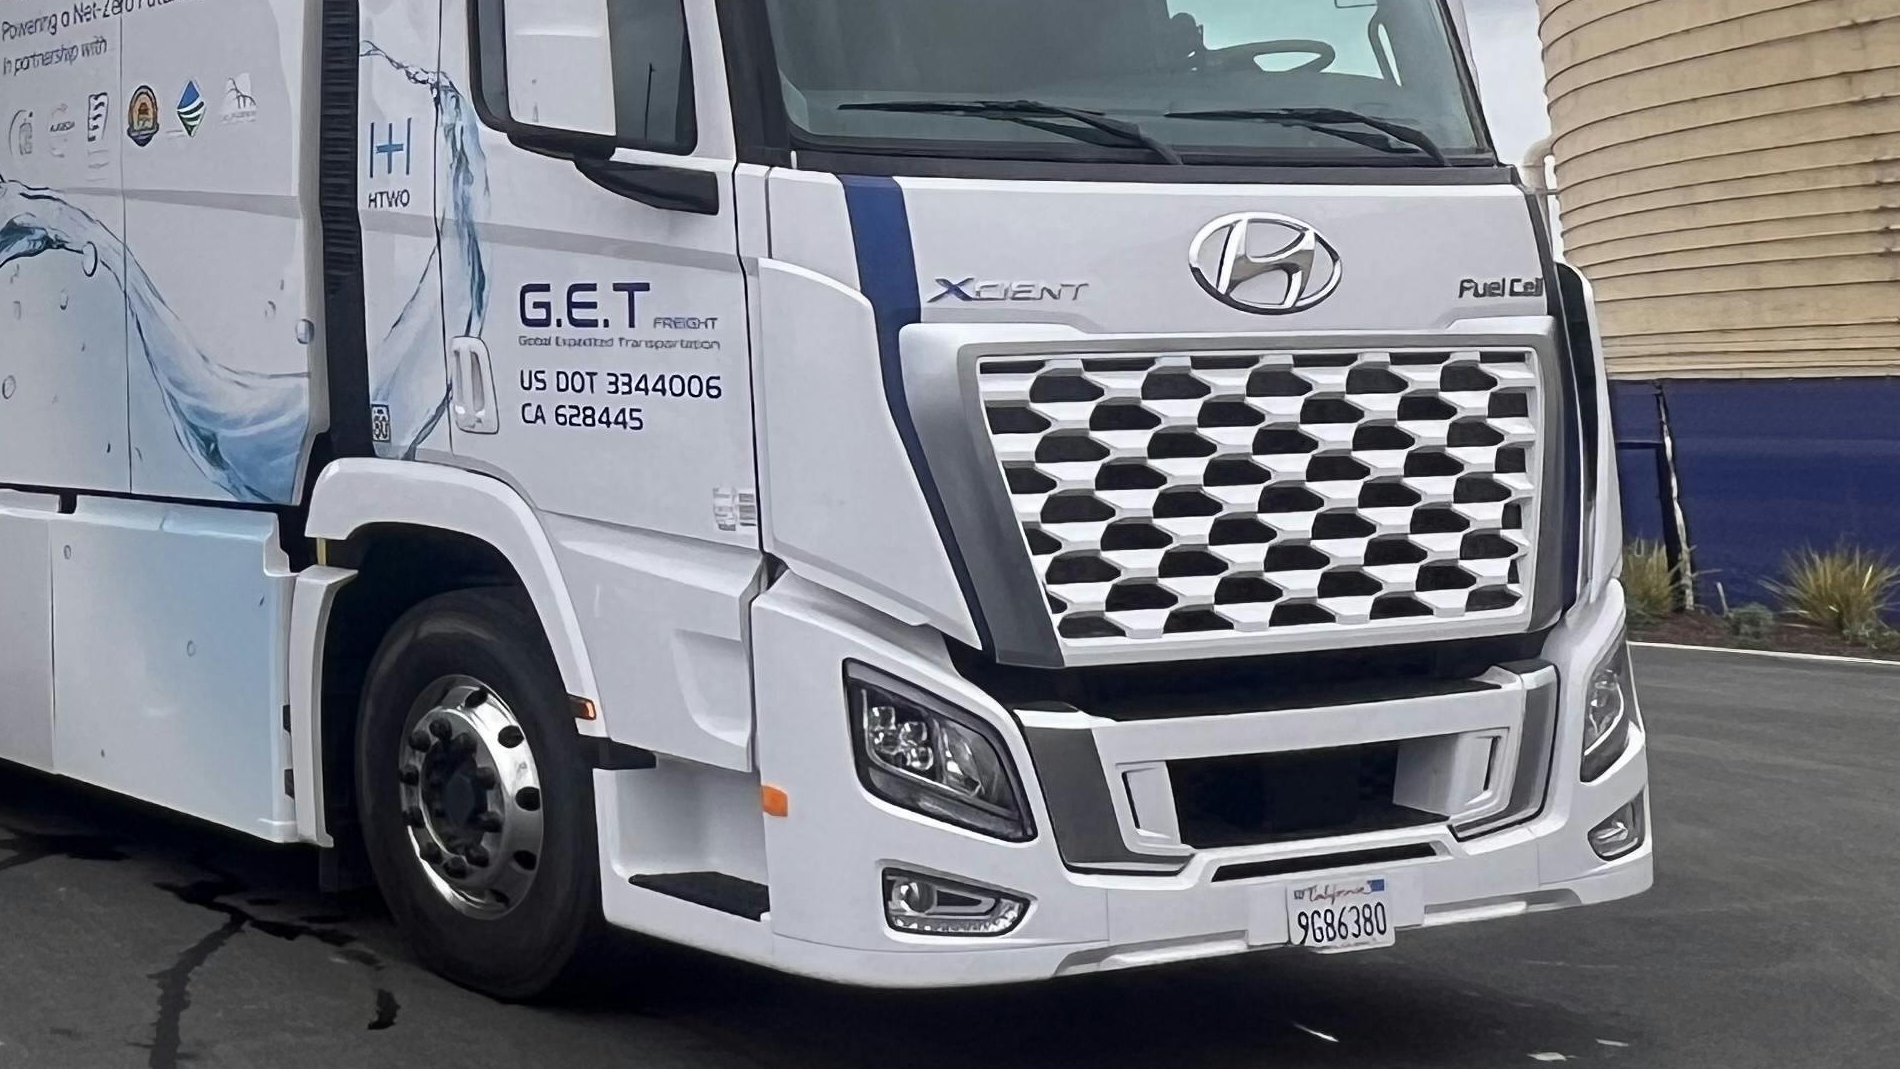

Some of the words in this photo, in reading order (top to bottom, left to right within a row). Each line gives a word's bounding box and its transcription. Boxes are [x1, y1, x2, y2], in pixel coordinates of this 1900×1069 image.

[368, 189, 410, 209] HTWO
[1458, 277, 1505, 298] Fuel
[1509, 277, 1544, 297] Cell
[519, 282, 651, 329] G.E.T
[653, 317, 719, 330] FREIGHT
[520, 369, 547, 392] US
[556, 371, 598, 394] DOT
[606, 373, 722, 399] 3344006
[521, 402, 547, 425] CA
[554, 404, 644, 431] 628445
[1297, 901, 1387, 945] 9G86380
